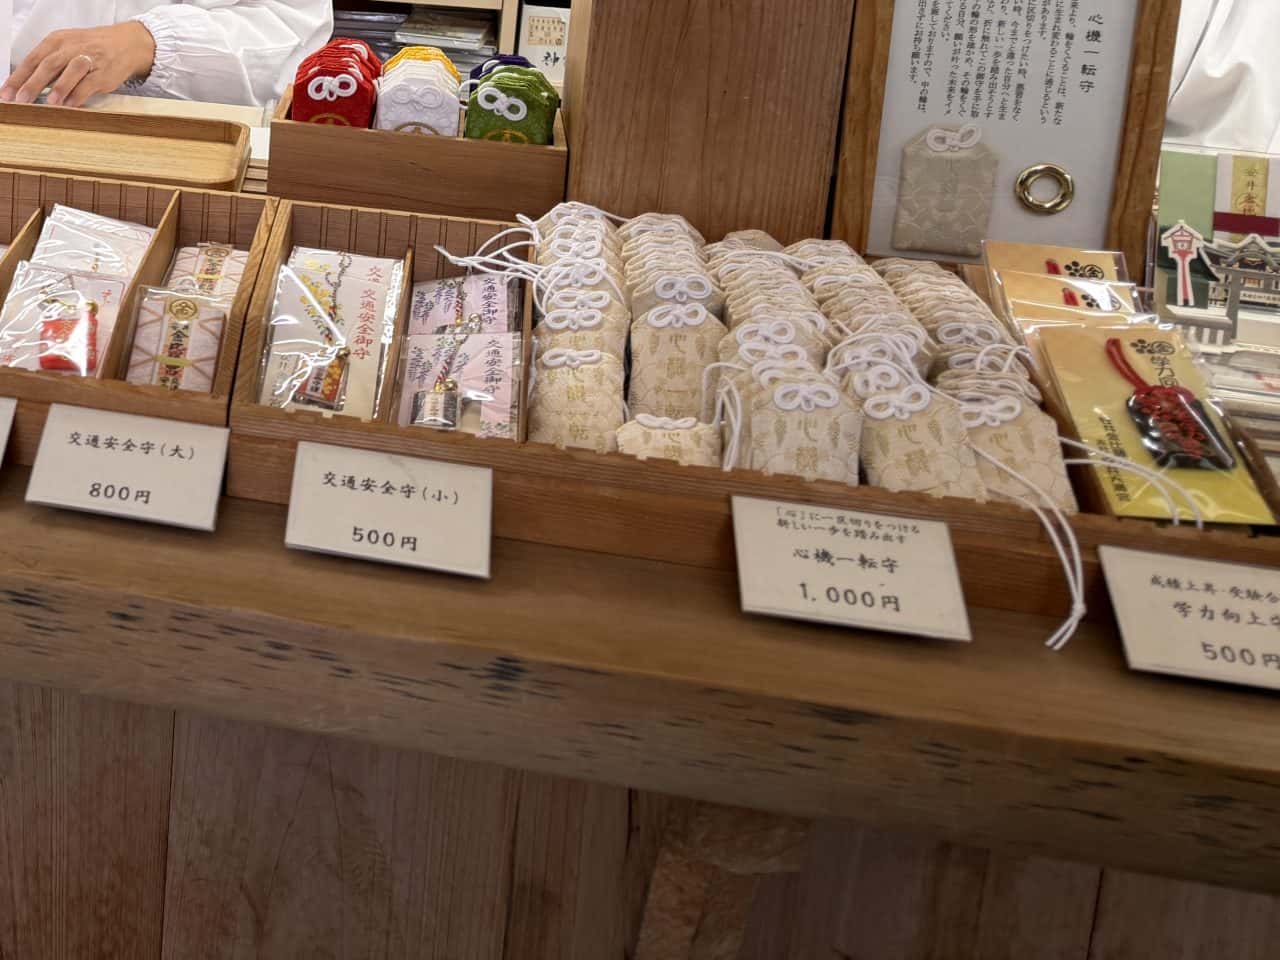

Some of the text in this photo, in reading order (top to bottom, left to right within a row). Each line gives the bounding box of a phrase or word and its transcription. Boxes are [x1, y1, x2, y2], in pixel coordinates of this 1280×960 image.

[1079, 13, 1104, 93] 心機一転守
[67, 431, 195, 461] 交通安全守(大)
[88, 482, 151, 505] 800円
[322, 471, 459, 505] 交通安全守(小)
[352, 526, 418, 551] 500円
[792, 548, 899, 574] 心機一転守
[1201, 641, 1280, 671] 500円
